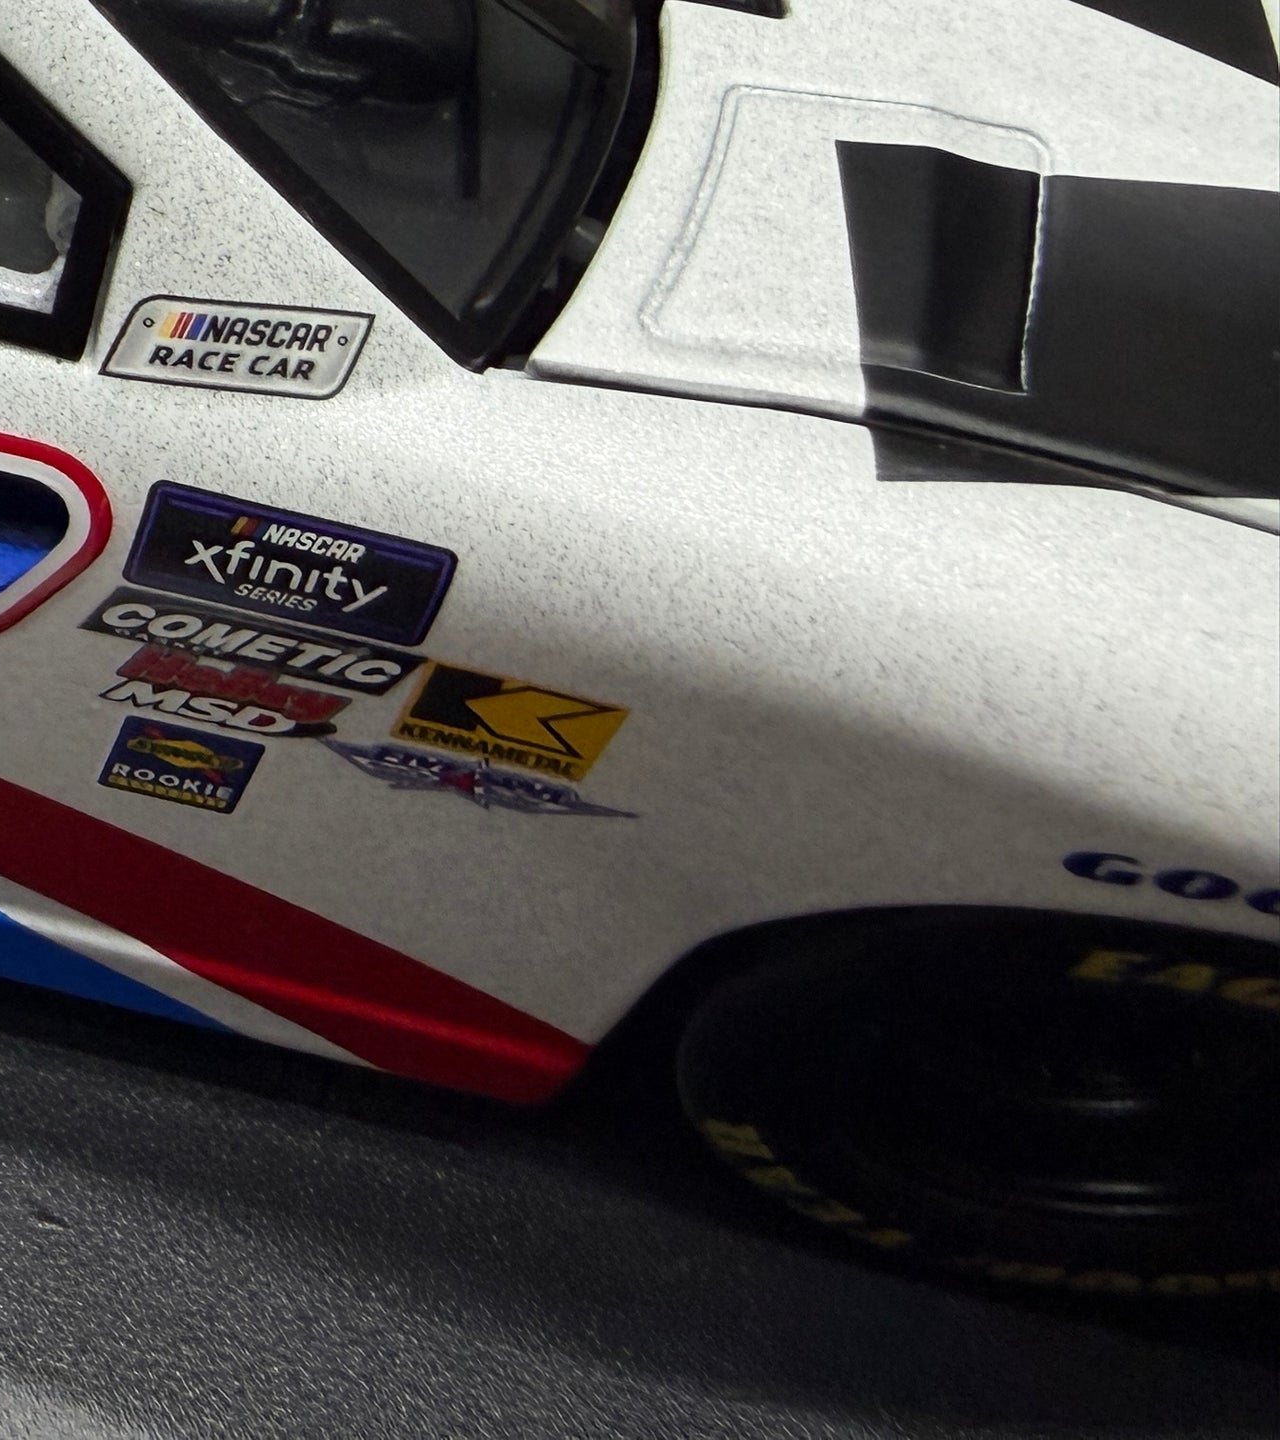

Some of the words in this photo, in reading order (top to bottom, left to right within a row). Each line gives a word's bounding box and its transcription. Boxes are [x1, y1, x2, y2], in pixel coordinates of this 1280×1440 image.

[203, 313, 335, 353] NASCAR
[148, 344, 239, 374] RACE
[248, 350, 317, 381] CAR
[261, 523, 367, 564] NASCAR
[184, 539, 388, 613] xfinity
[233, 583, 319, 612] SERIES
[101, 602, 402, 684] COMETIC
[98, 679, 298, 735] MSD
[111, 762, 234, 801] ROOKIE
